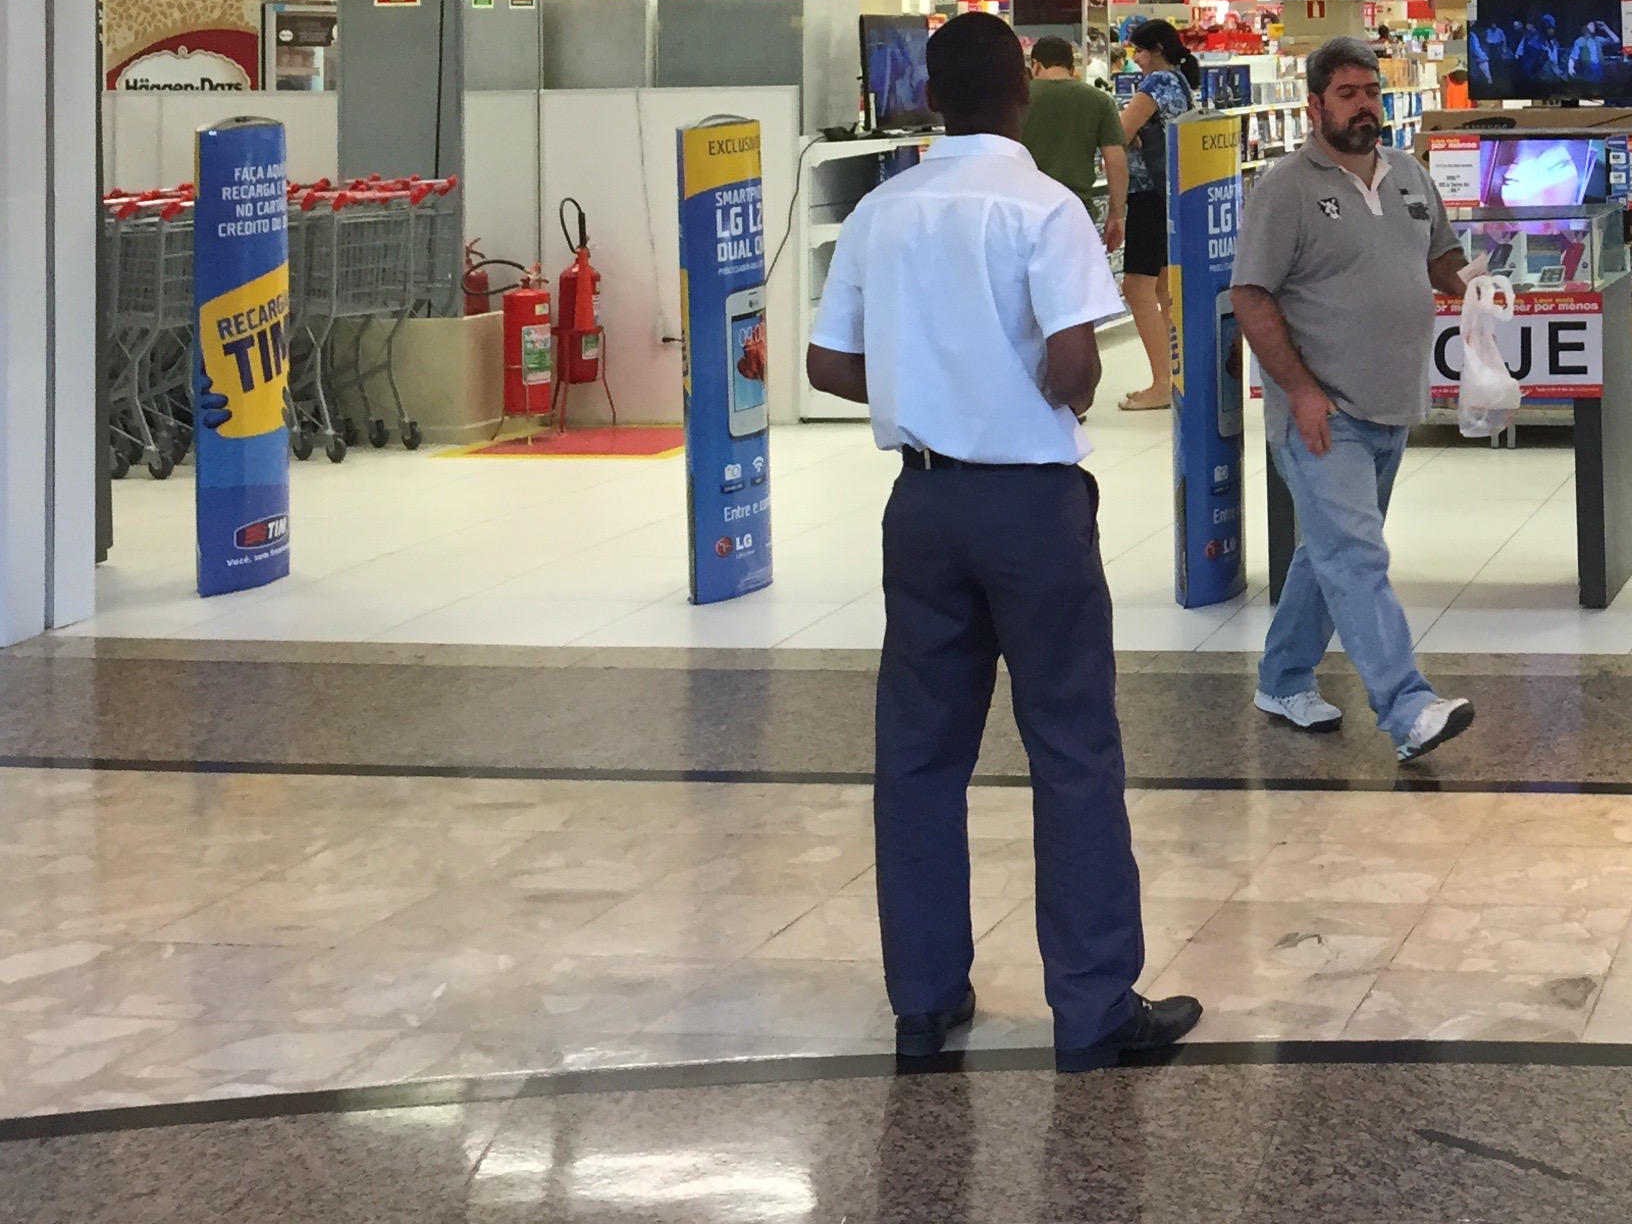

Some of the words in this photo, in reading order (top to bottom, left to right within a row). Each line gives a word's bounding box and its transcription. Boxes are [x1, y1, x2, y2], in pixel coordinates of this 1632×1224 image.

[234, 165, 265, 184] FAÇA
[221, 183, 276, 201] RECARGA
[236, 200, 254, 218] NO
[1207, 201, 1232, 236] LG
[217, 218, 270, 238] CRÉDITO
[716, 206, 743, 239] LG
[717, 240, 753, 263] DUAL
[1534, 304, 1555, 312] por
[1558, 302, 1599, 311] menos
[723, 504, 750, 523] Entre
[267, 517, 287, 540] TIM
[735, 533, 753, 551] LG
